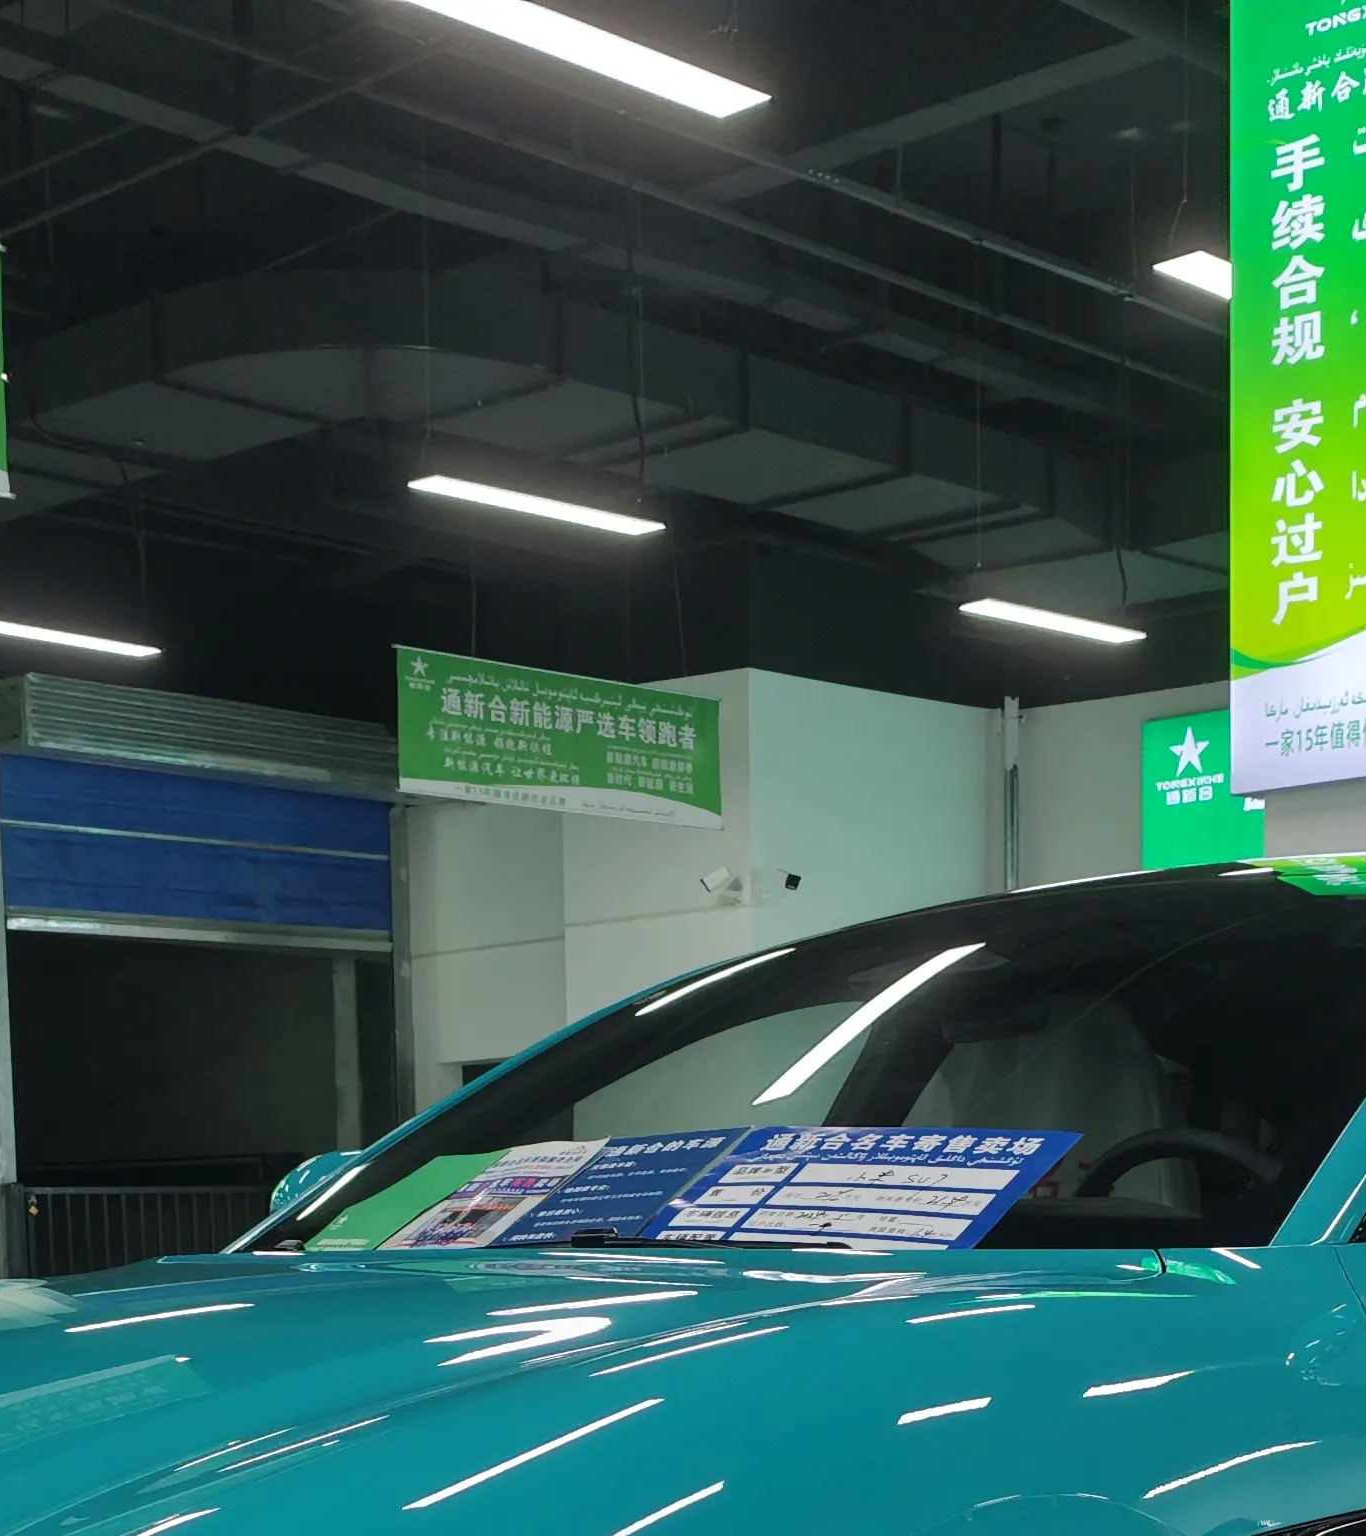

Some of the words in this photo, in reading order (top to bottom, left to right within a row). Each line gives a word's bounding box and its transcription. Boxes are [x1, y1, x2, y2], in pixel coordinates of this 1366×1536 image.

[1270, 134, 1326, 367] 手续合规
[1270, 398, 1325, 627] 安心过户
[440, 686, 697, 751] 通新合新能源严选车领跑者
[759, 1132, 1046, 1157] 通新合名车寄售卖场
